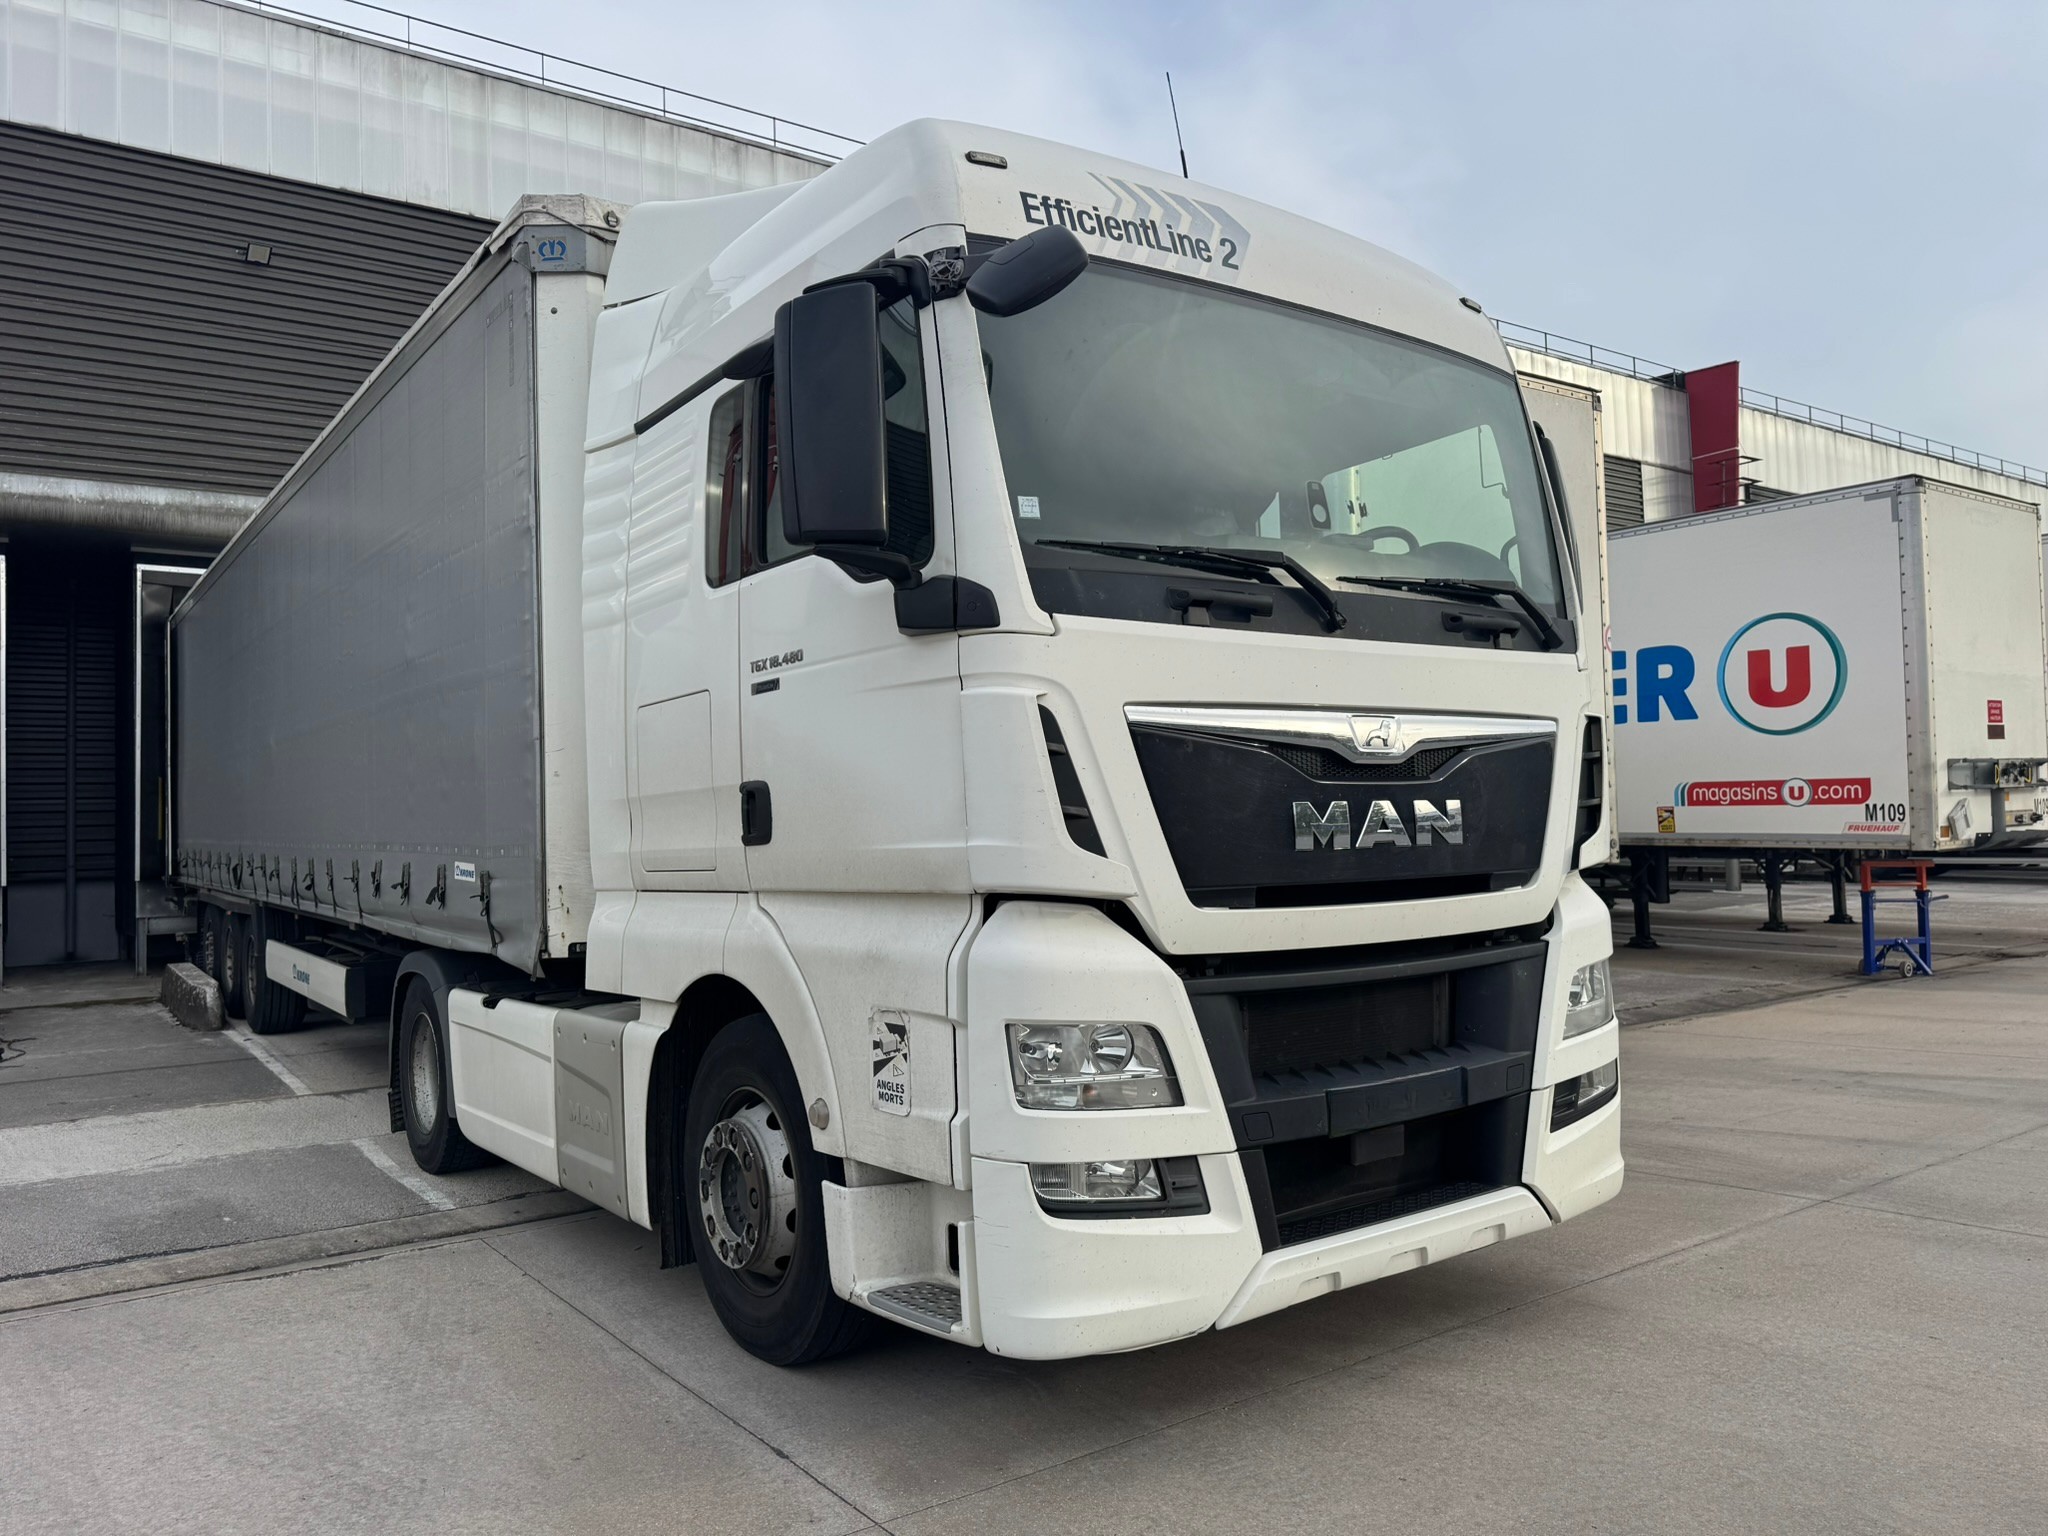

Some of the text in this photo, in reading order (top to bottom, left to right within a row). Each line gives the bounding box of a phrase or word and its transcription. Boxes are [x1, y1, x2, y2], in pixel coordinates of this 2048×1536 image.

[1019, 191, 1239, 270] EfficientLine 2
[750, 649, 803, 674] TGX 18.480
[1747, 645, 1811, 708] U
[1693, 783, 1778, 804] magasins
[1864, 803, 1906, 822] M109
[1292, 800, 1464, 852] MAN
[1847, 824, 1901, 833] FRUEHAUF
[876, 1079, 905, 1093] ANGLES
[878, 1091, 904, 1105] MORTS
